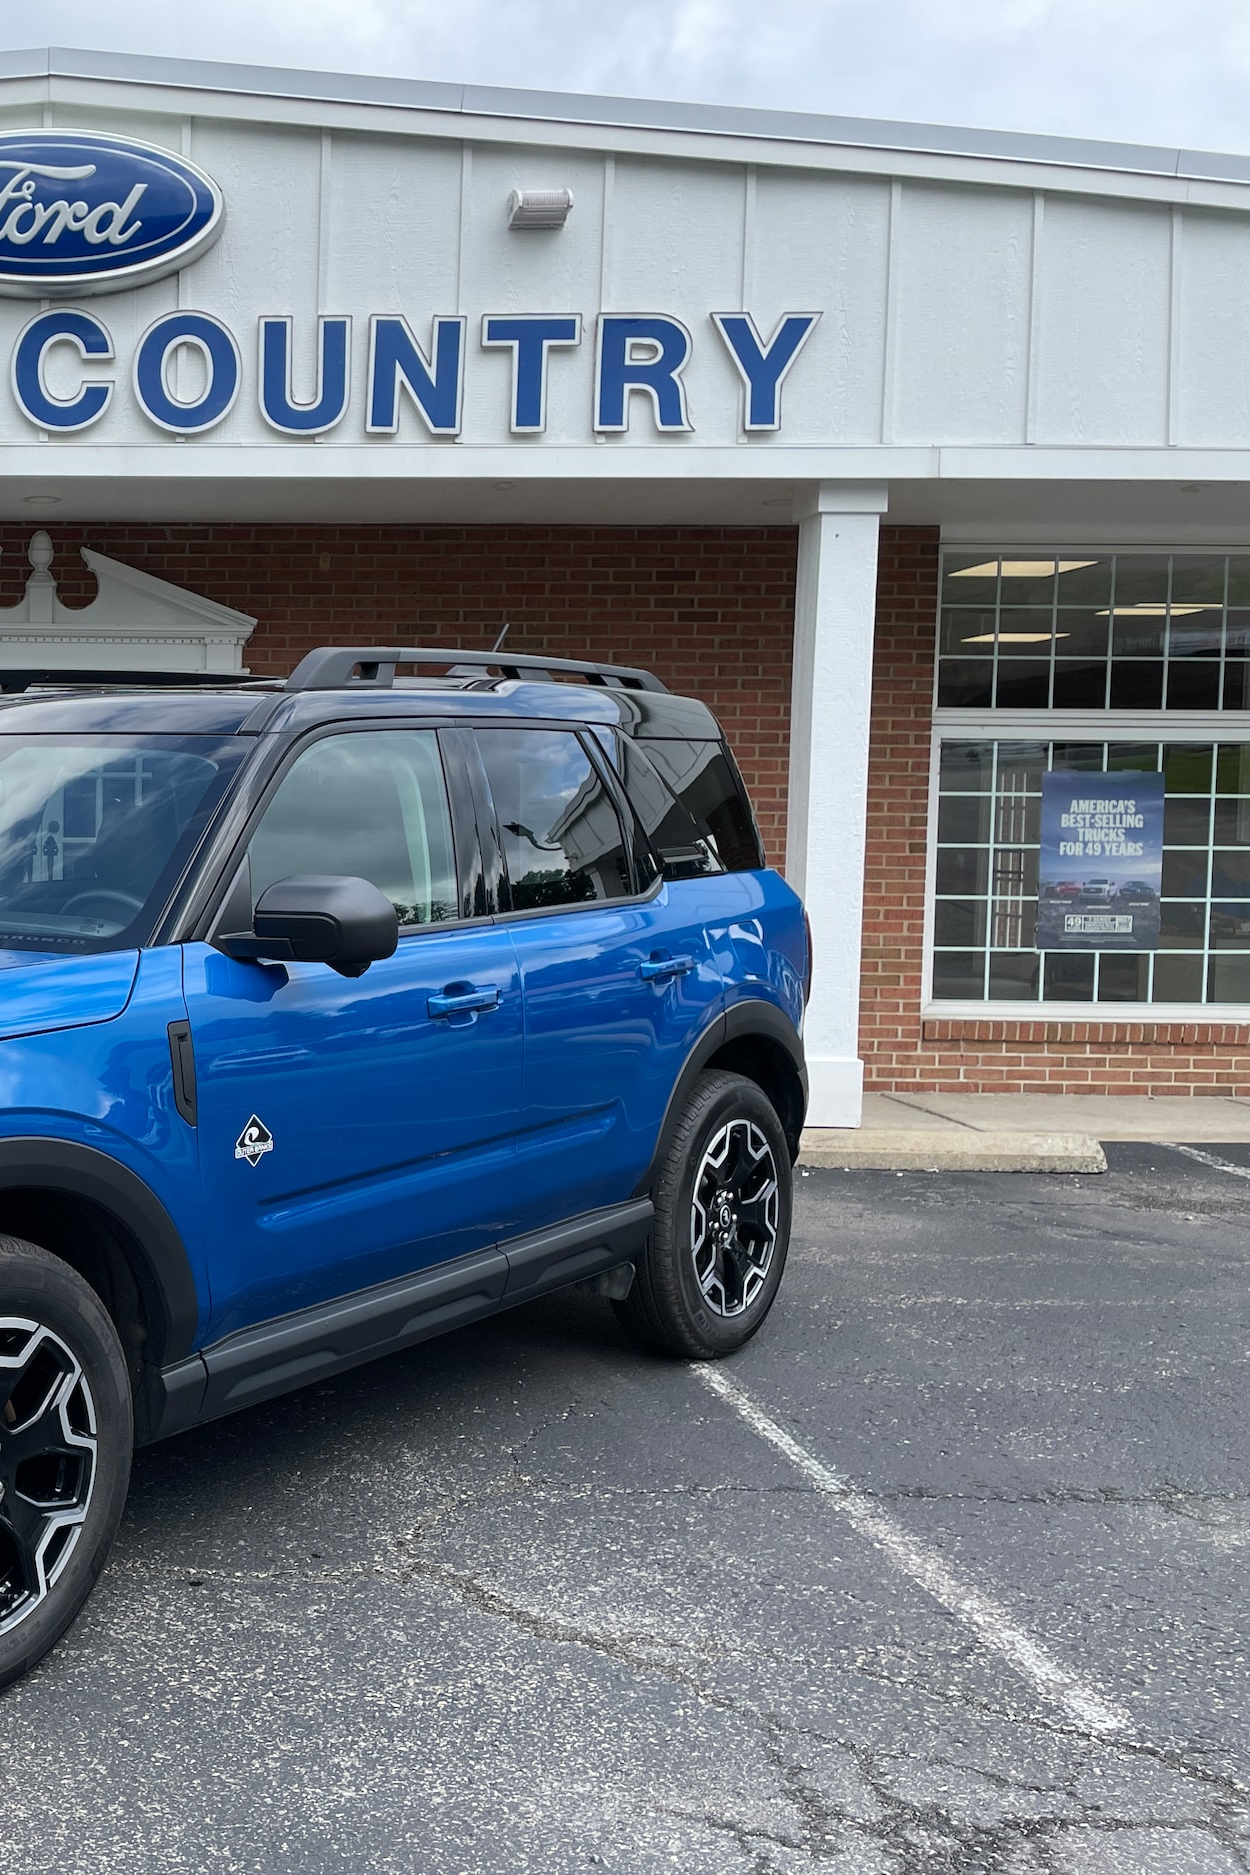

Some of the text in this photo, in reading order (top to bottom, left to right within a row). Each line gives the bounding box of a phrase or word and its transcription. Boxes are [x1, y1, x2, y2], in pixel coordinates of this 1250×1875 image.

[10, 307, 825, 435] COUNTRY
[1070, 799, 1136, 814] AMERICA'S
[1061, 814, 1144, 828] BEST-SELLING
[1077, 828, 1126, 842] TRUCKS
[1059, 842, 1144, 856] FOR 49 YEARS
[1067, 916, 1082, 928] 49
